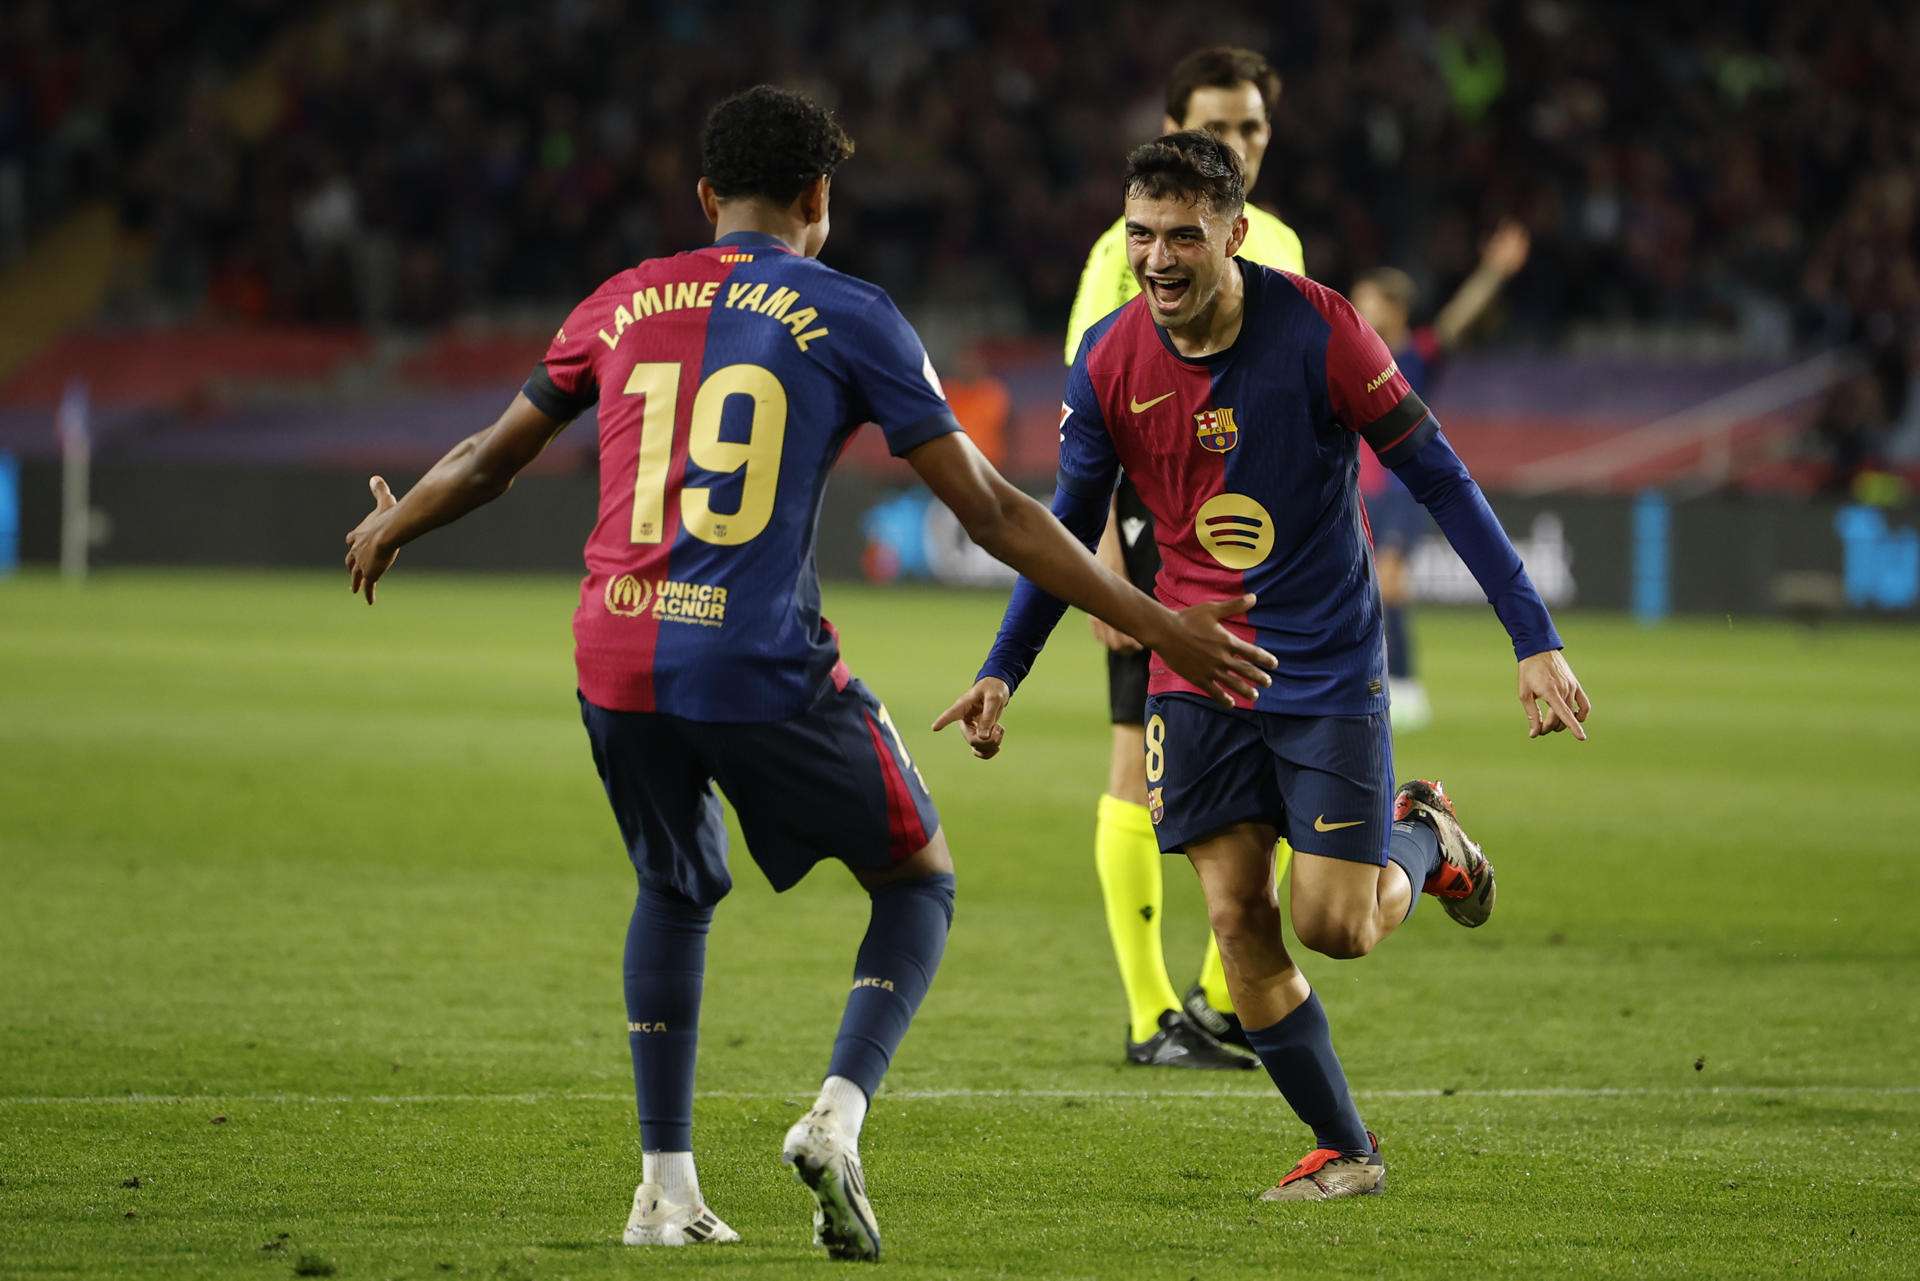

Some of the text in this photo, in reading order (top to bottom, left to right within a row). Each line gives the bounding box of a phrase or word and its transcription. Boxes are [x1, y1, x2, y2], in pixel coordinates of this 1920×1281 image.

[599, 282, 829, 352] LAMINE YAMAL
[623, 362, 787, 546] 19
[652, 598, 725, 619] ACNUR
[656, 580, 727, 604] UNHCR
[1146, 714, 1165, 782] 8
